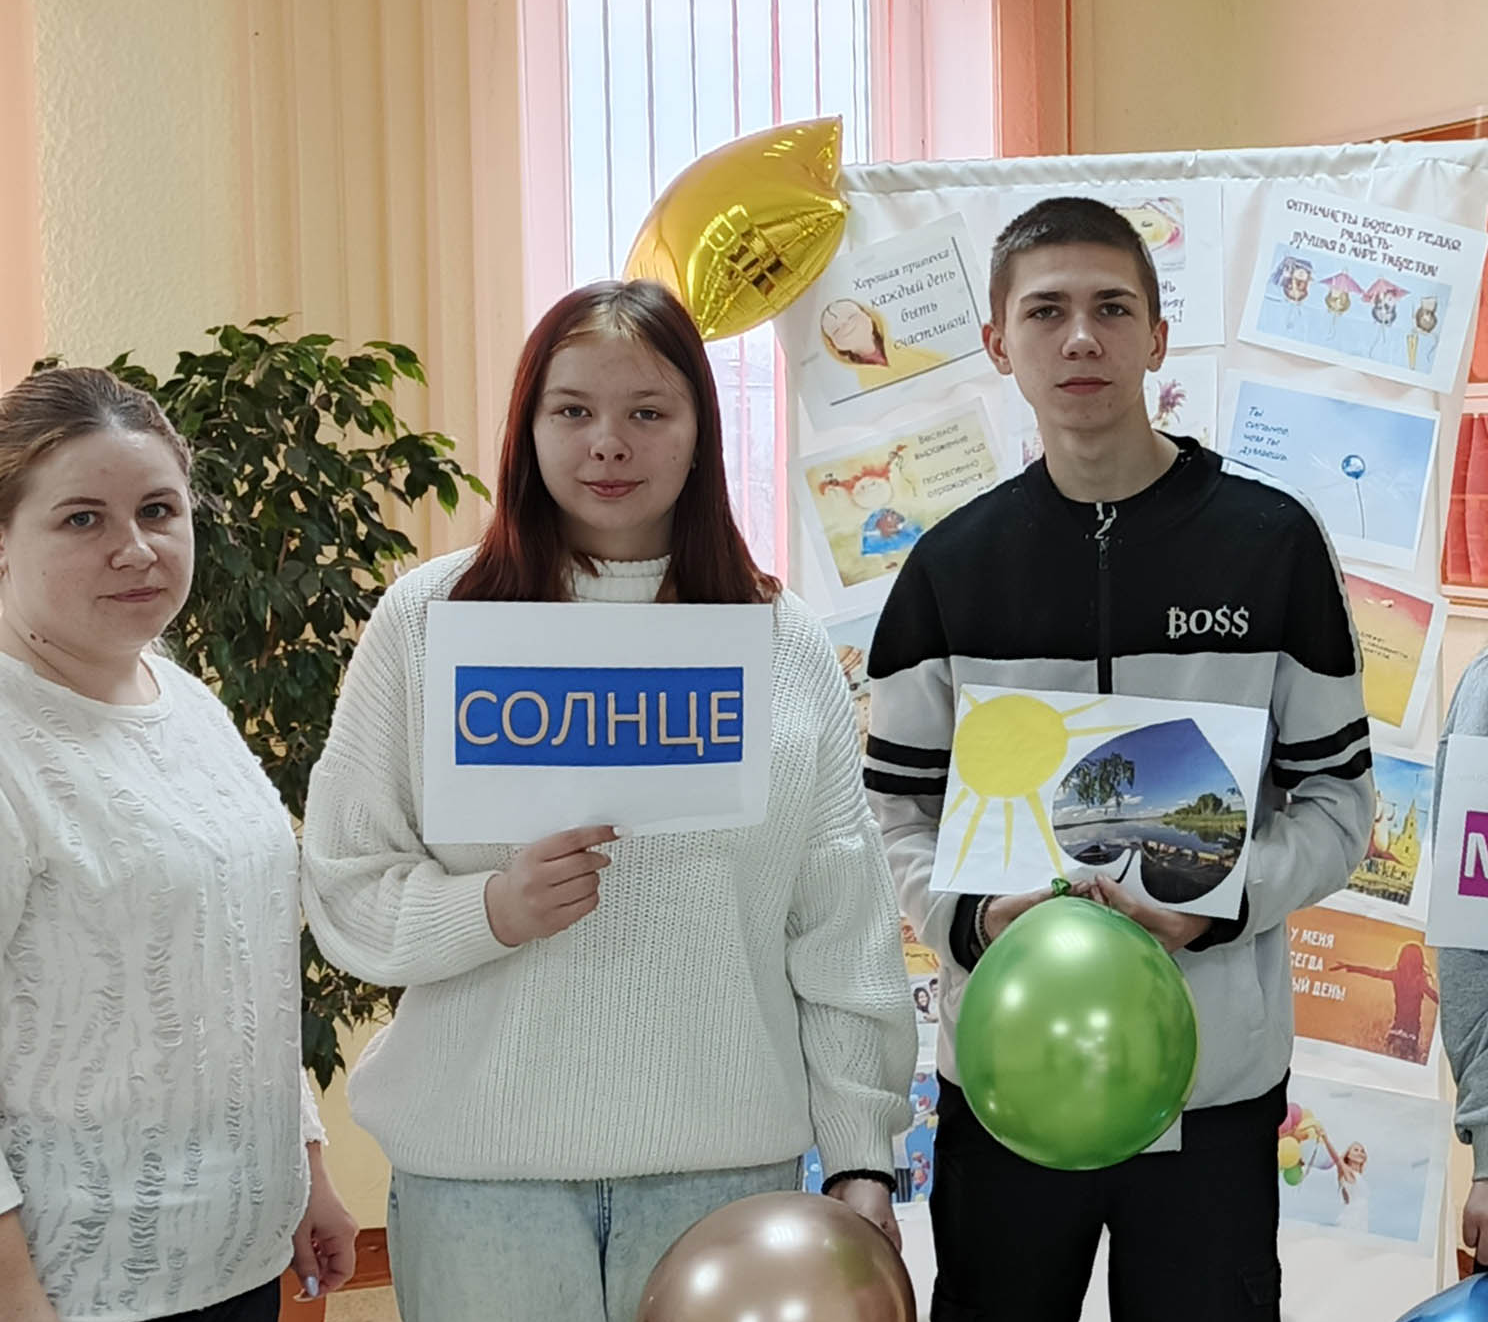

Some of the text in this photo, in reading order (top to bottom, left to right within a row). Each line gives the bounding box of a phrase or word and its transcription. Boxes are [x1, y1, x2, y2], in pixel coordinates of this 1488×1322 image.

[870, 269, 957, 308] каждый день
[900, 301, 939, 323] быть
[457, 689, 742, 758] СОЛНЦЕ
[1301, 928, 1336, 950] МЕНЯ
[1289, 950, 1324, 972] СЕГДА
[1311, 979, 1348, 1002] ДЕНЬ!
